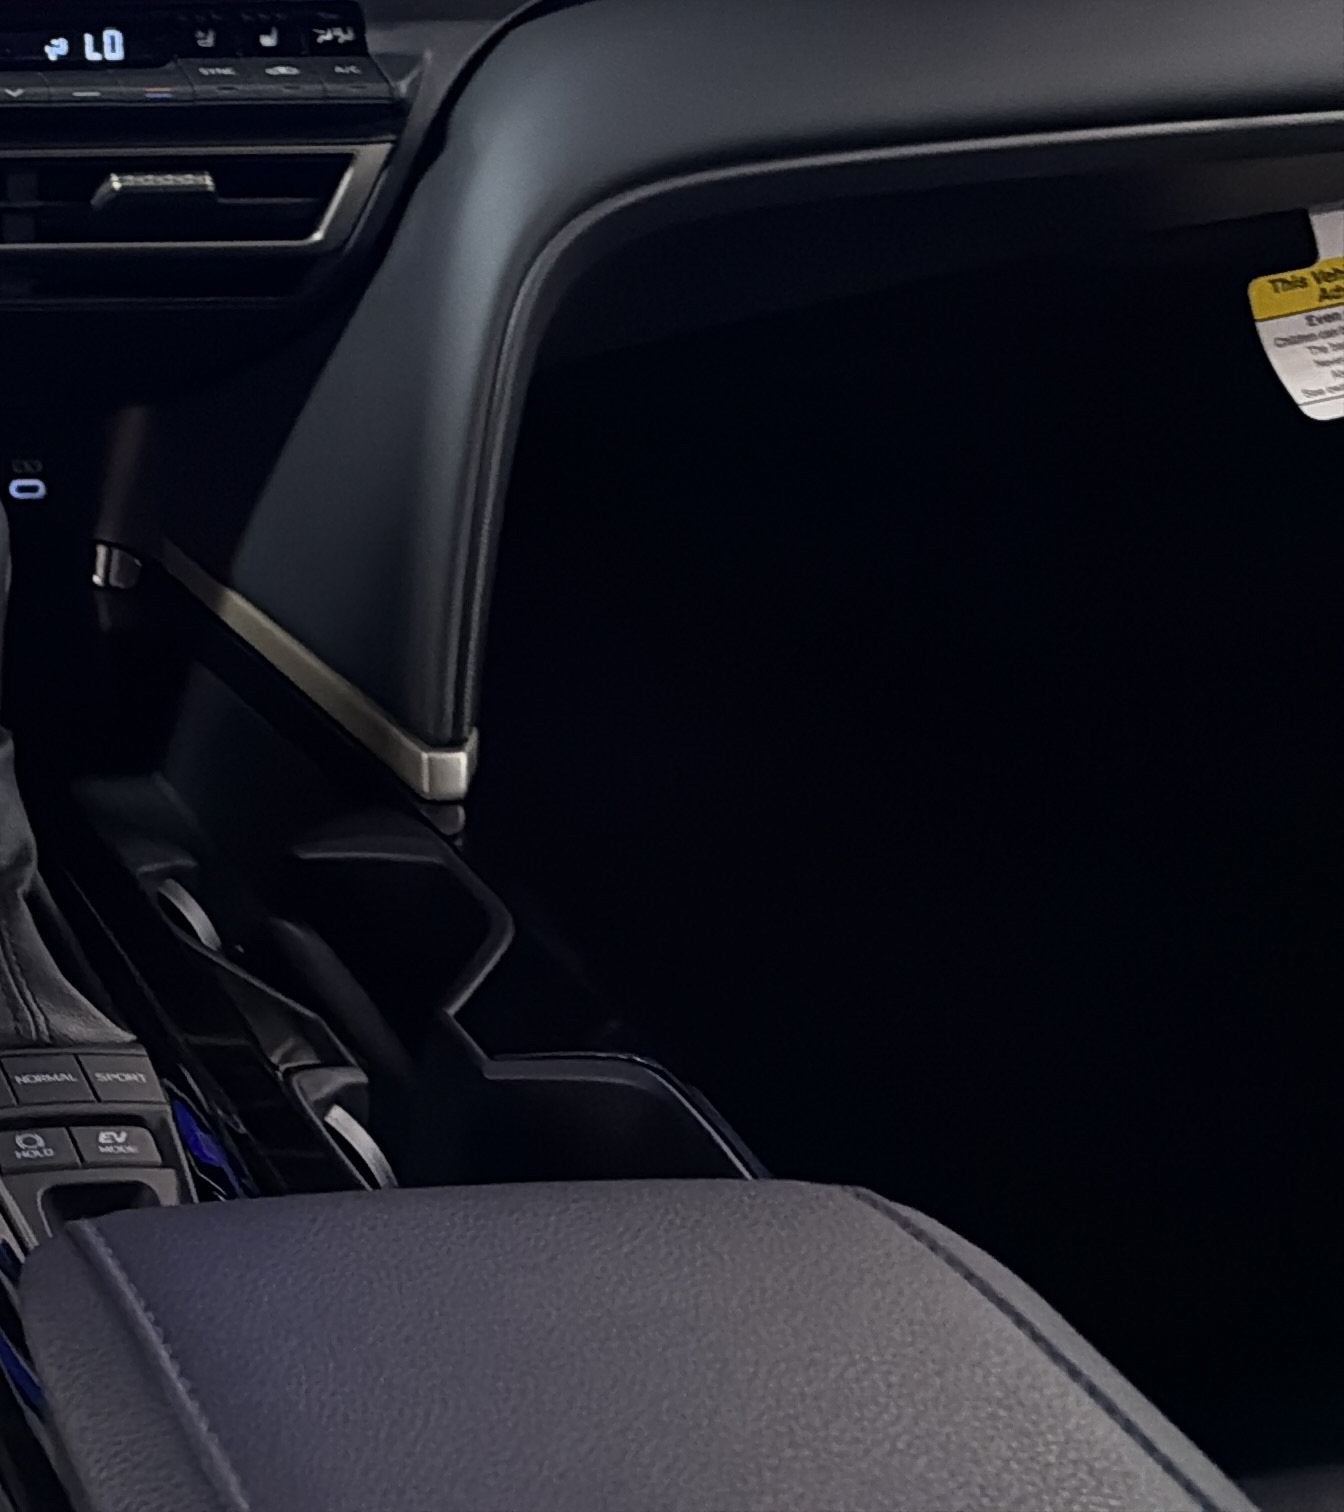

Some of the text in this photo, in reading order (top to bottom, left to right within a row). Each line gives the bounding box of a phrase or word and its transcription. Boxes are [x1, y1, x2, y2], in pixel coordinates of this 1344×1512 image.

[15, 1071, 78, 1085] NORMAL
[94, 1071, 148, 1084] SPORT
[98, 1131, 129, 1144] EV
[14, 1147, 56, 1160] HOLD
